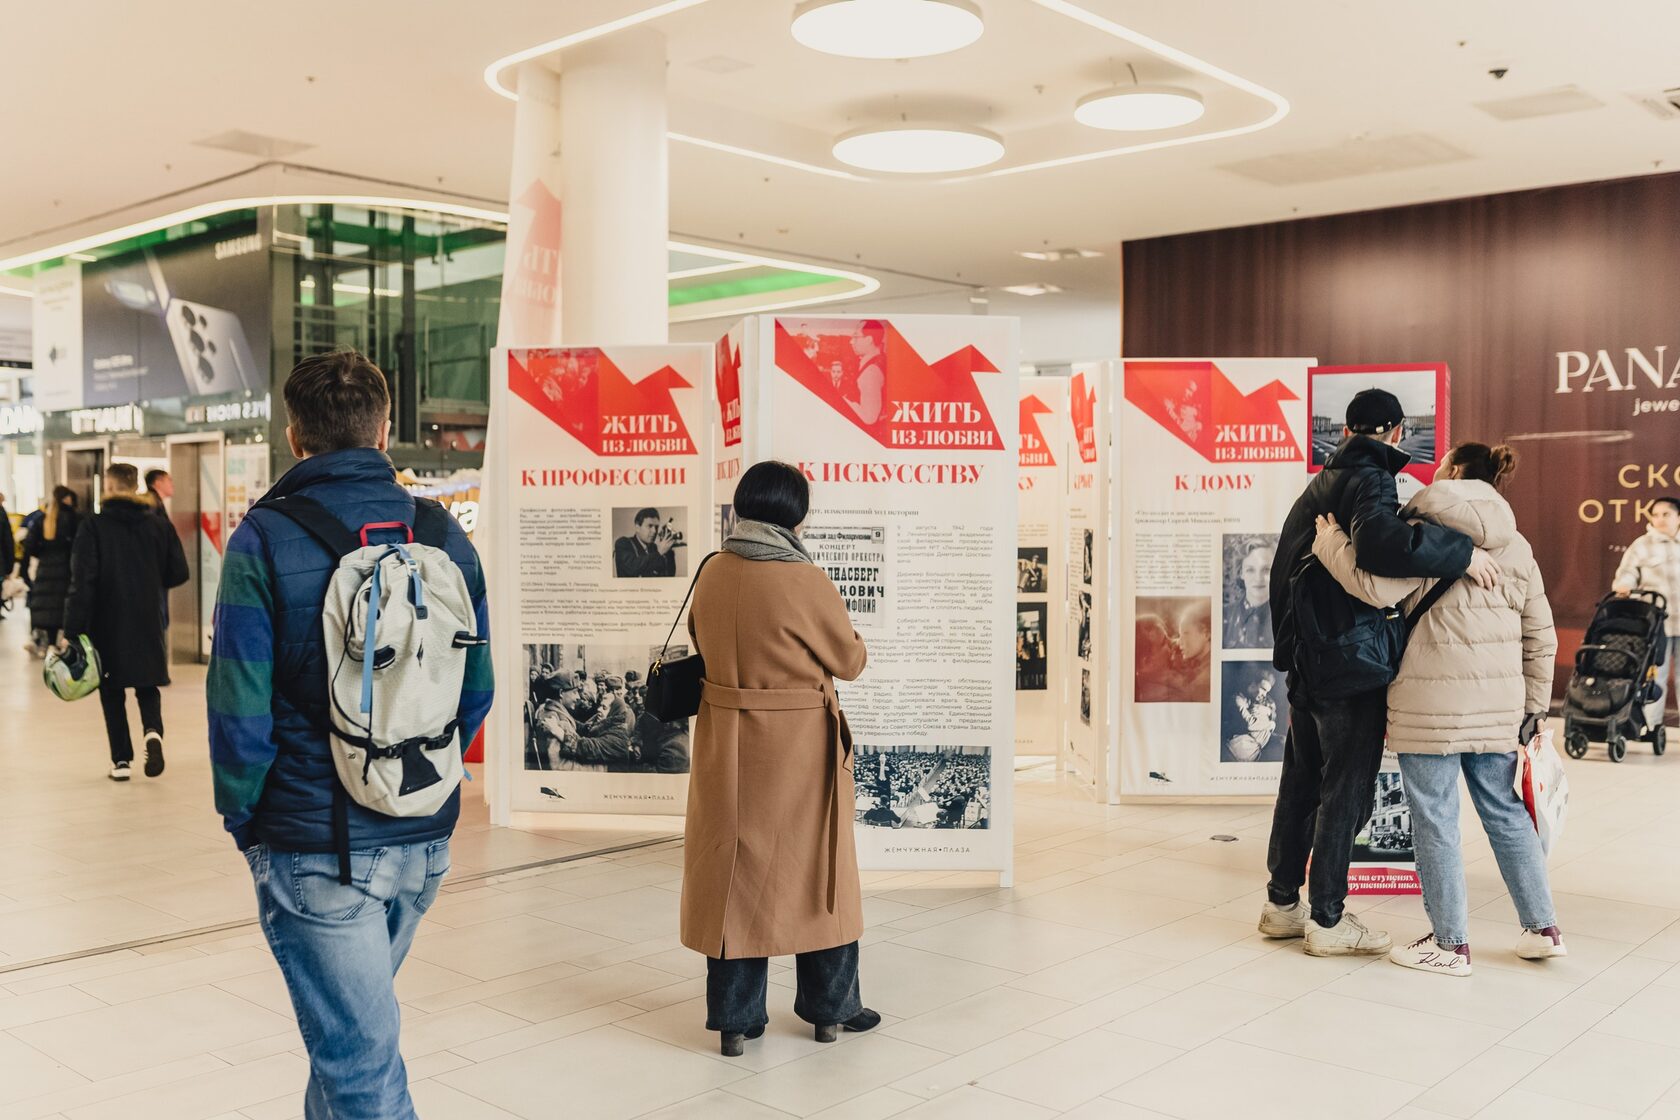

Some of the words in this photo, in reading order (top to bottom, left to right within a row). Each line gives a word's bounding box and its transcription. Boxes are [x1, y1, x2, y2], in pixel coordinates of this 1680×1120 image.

[890, 400, 982, 424] ЖИТЬ
[602, 414, 678, 434] ЖИТЬ
[892, 430, 917, 445] ИЗ
[920, 430, 993, 446] ЛЮБВИ
[1019, 433, 1041, 449] ТЬ
[1215, 424, 1286, 442] ЖИТЬ
[602, 439, 624, 452] ИЗ
[626, 438, 688, 452] ЛЮБВИ
[1215, 447, 1236, 460] ИЗ
[1238, 446, 1295, 459] ЛЮБВИ
[522, 470, 536, 486] К
[542, 468, 686, 486] ПРОФЕССИИ
[798, 462, 816, 482] К
[822, 462, 984, 484] ИСКУССТВУ
[1618, 464, 1680, 488] СК
[1175, 474, 1188, 490] К
[1192, 474, 1256, 492] ДОМУ
[809, 552, 848, 561] НИЧЕСКОГО
[852, 552, 884, 562] ОРКЕСТРА
[822, 567, 879, 582] ЛИАСБЕРГ
[840, 585, 884, 598] КОВИЧ
[846, 598, 876, 613] МФОНИЯ
[1348, 880, 1396, 890] рушенной
[1370, 874, 1414, 882] ступенях
[1414, 952, 1461, 969] Karl
